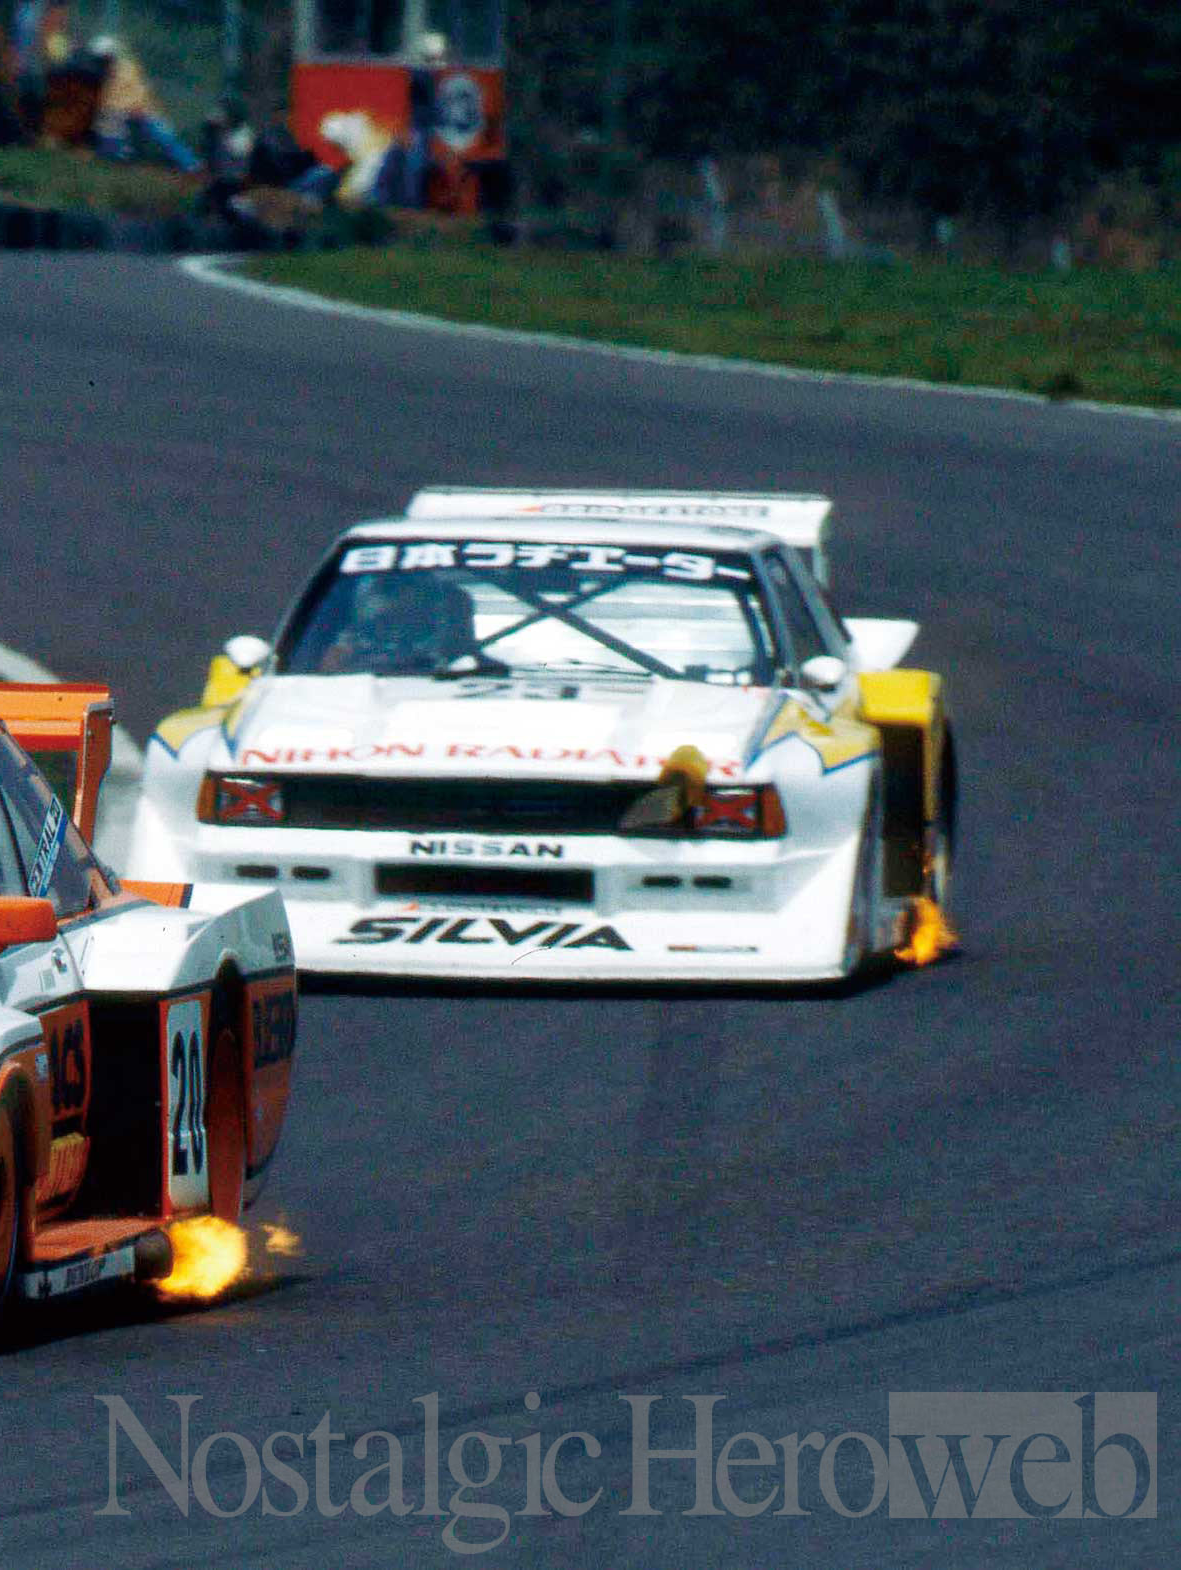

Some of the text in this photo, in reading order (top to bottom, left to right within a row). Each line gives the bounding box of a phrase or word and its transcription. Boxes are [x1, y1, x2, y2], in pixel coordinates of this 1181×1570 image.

[241, 742, 741, 778] NIHON RADIATR
[409, 840, 565, 859] NISSAN
[333, 916, 636, 952] SILVIA
[171, 1029, 204, 1177] 20
